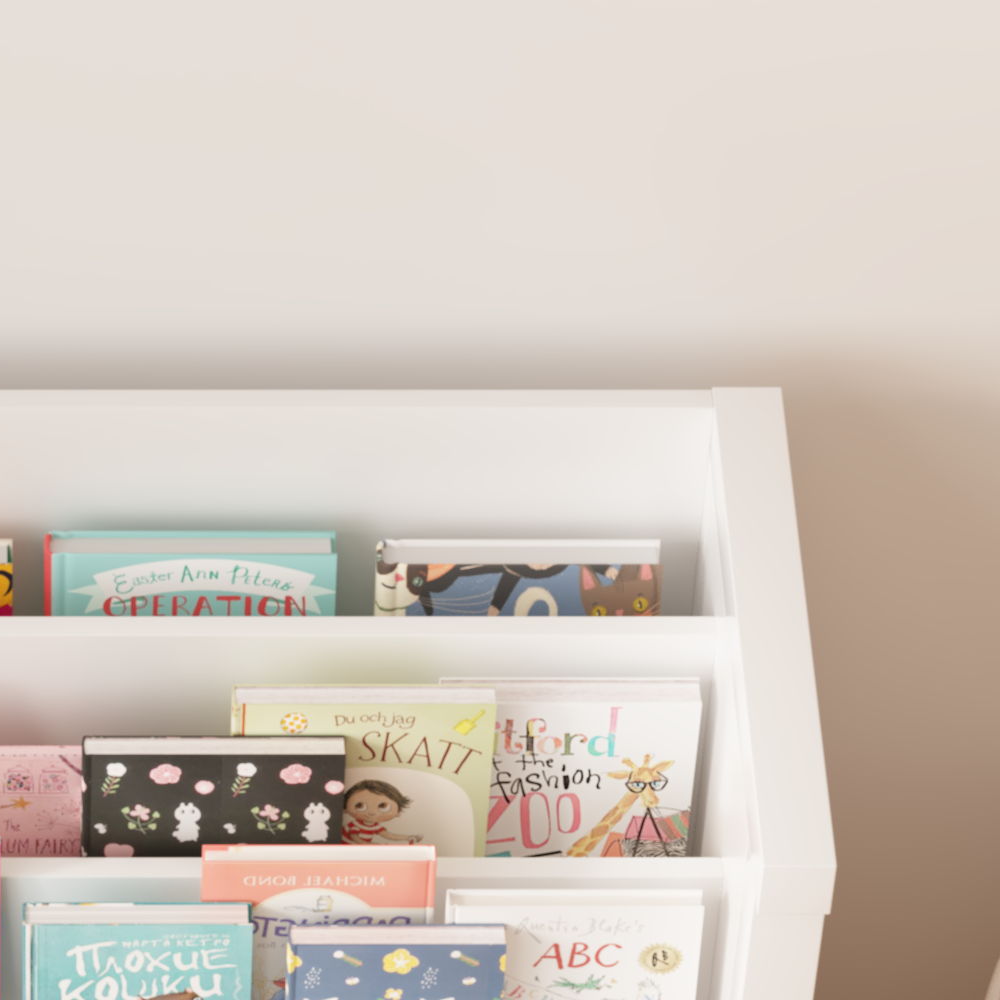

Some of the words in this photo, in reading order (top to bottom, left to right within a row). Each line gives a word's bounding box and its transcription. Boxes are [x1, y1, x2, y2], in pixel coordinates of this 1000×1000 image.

[102, 595, 306, 616] OPERATION
[334, 714, 355, 727] Du
[360, 711, 386, 723] och
[358, 730, 483, 775] SKATT
[515, 754, 554, 772] the
[490, 764, 602, 805] fashion
[533, 942, 623, 970] ABC
